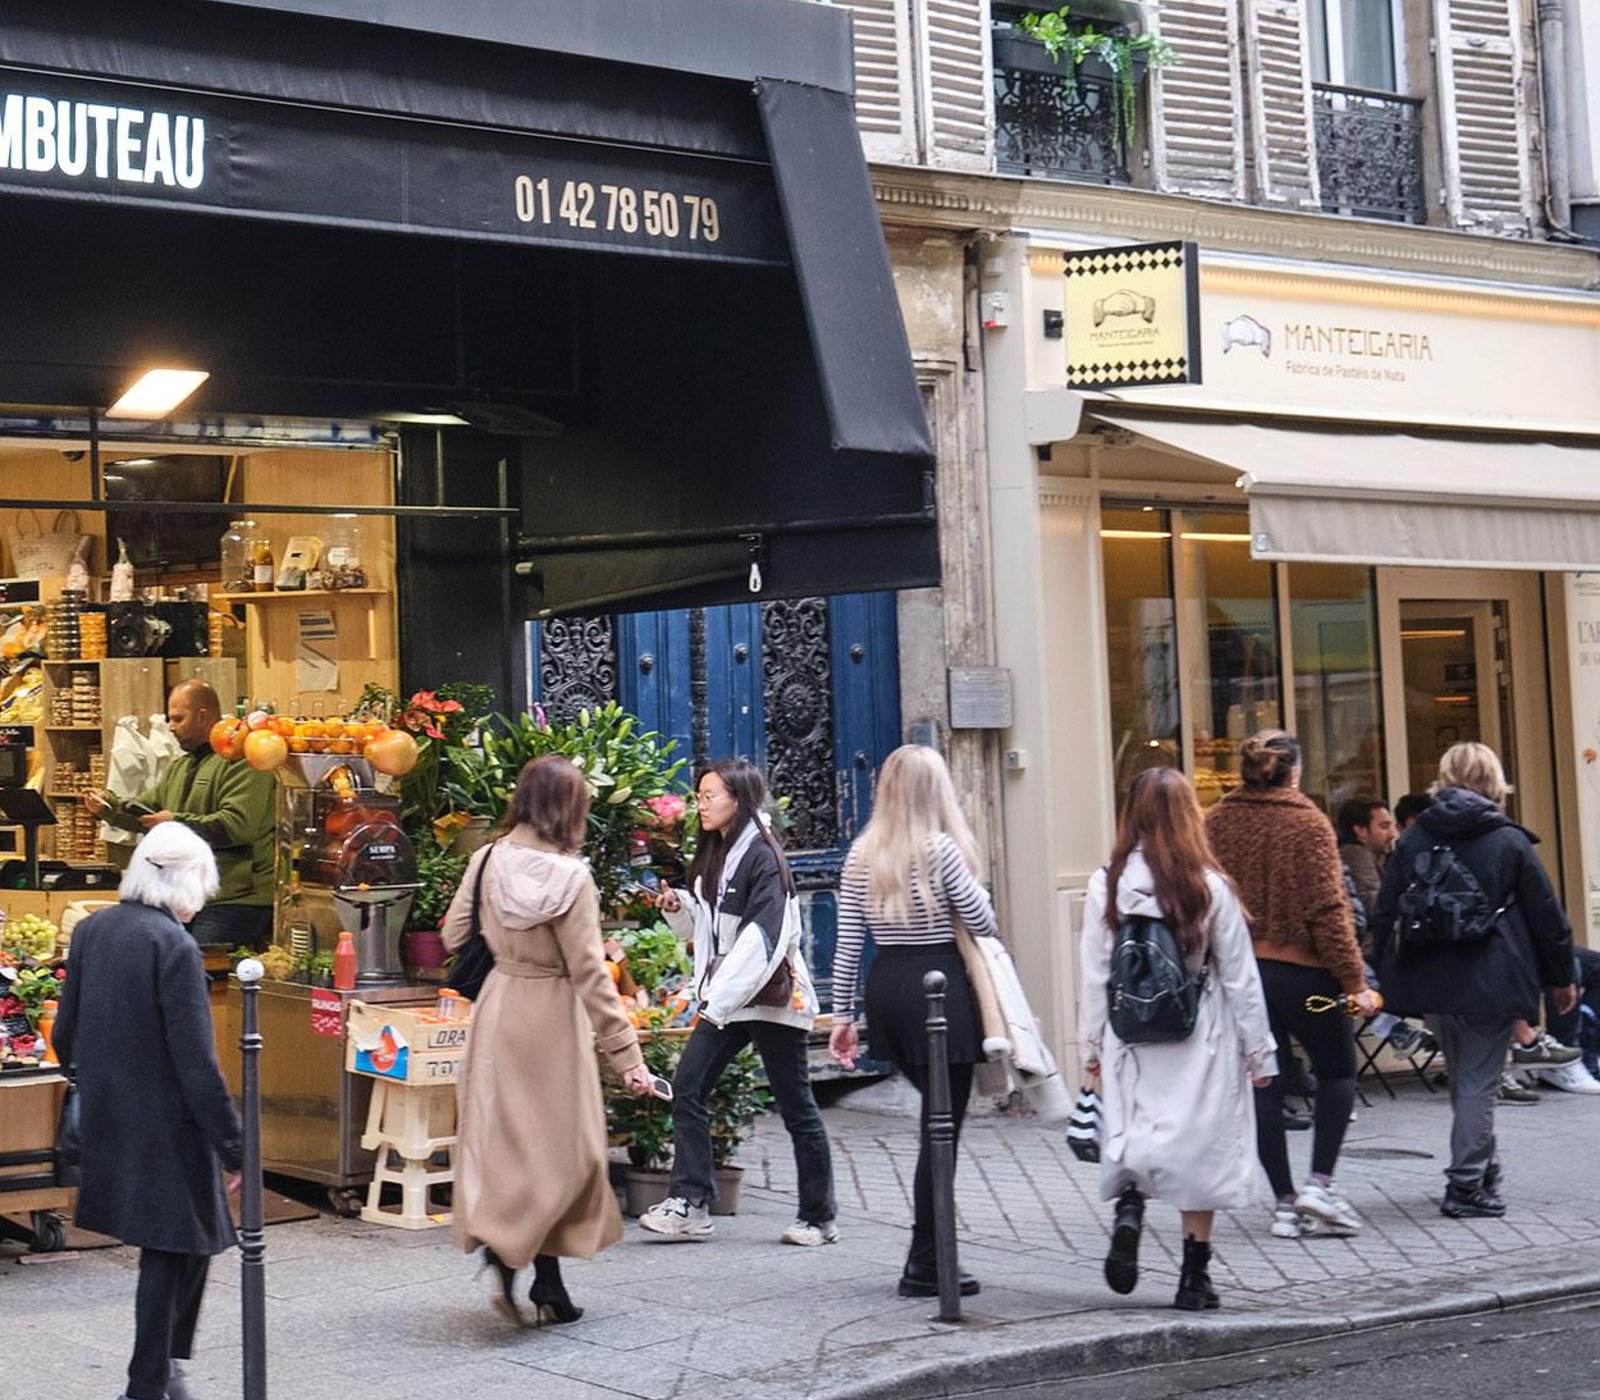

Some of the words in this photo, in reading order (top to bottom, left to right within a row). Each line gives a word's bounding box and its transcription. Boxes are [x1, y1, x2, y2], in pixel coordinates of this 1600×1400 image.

[515, 175, 551, 224] 01
[559, 181, 596, 228] 42
[601, 185, 638, 233] 78
[643, 190, 679, 238] 50
[683, 195, 720, 242] 79
[1285, 323, 1433, 361] MANTEIGARIA
[436, 1029, 467, 1045] ORA
